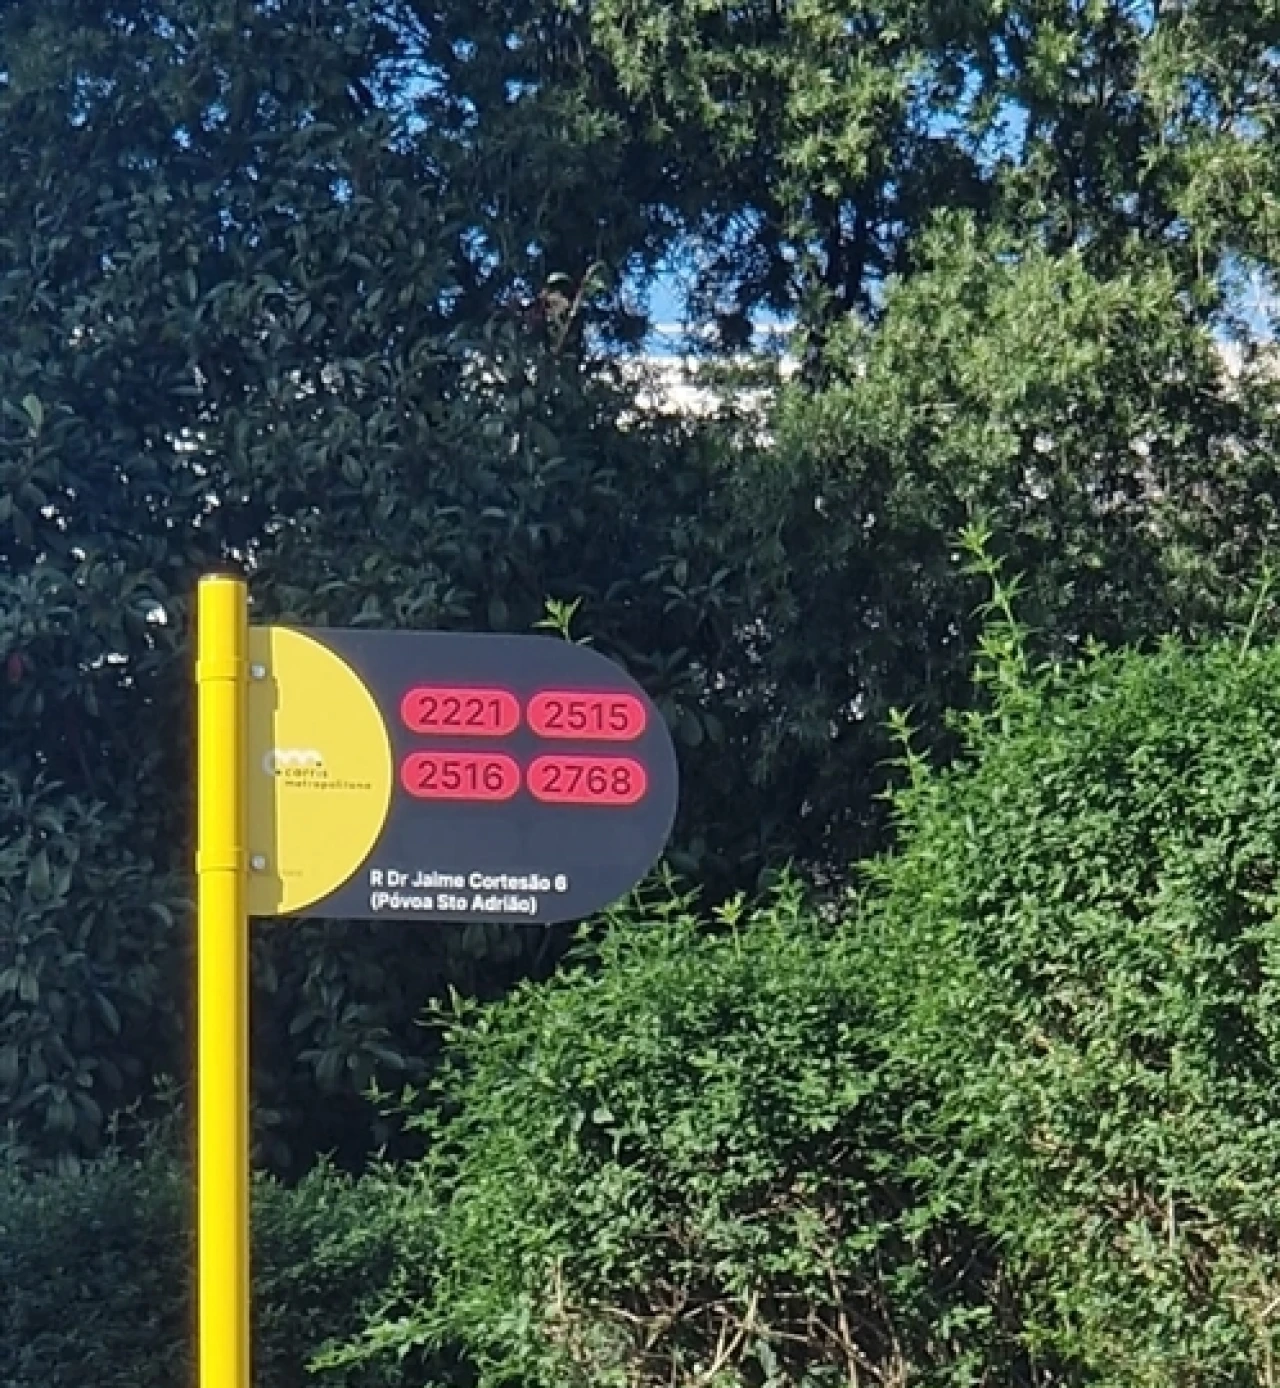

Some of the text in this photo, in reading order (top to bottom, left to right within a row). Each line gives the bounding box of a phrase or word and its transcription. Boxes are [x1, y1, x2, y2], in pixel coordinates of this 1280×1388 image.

[418, 696, 501, 726] 2221
[544, 701, 629, 731] 2515
[418, 760, 503, 791] 2516
[541, 765, 632, 795] 2768
[369, 869, 383, 888] R
[387, 869, 410, 888] Dr
[411, 870, 465, 888] Jaime
[468, 871, 551, 891] Cortesão
[370, 890, 538, 915] (Póvoa Sto Adrião)
